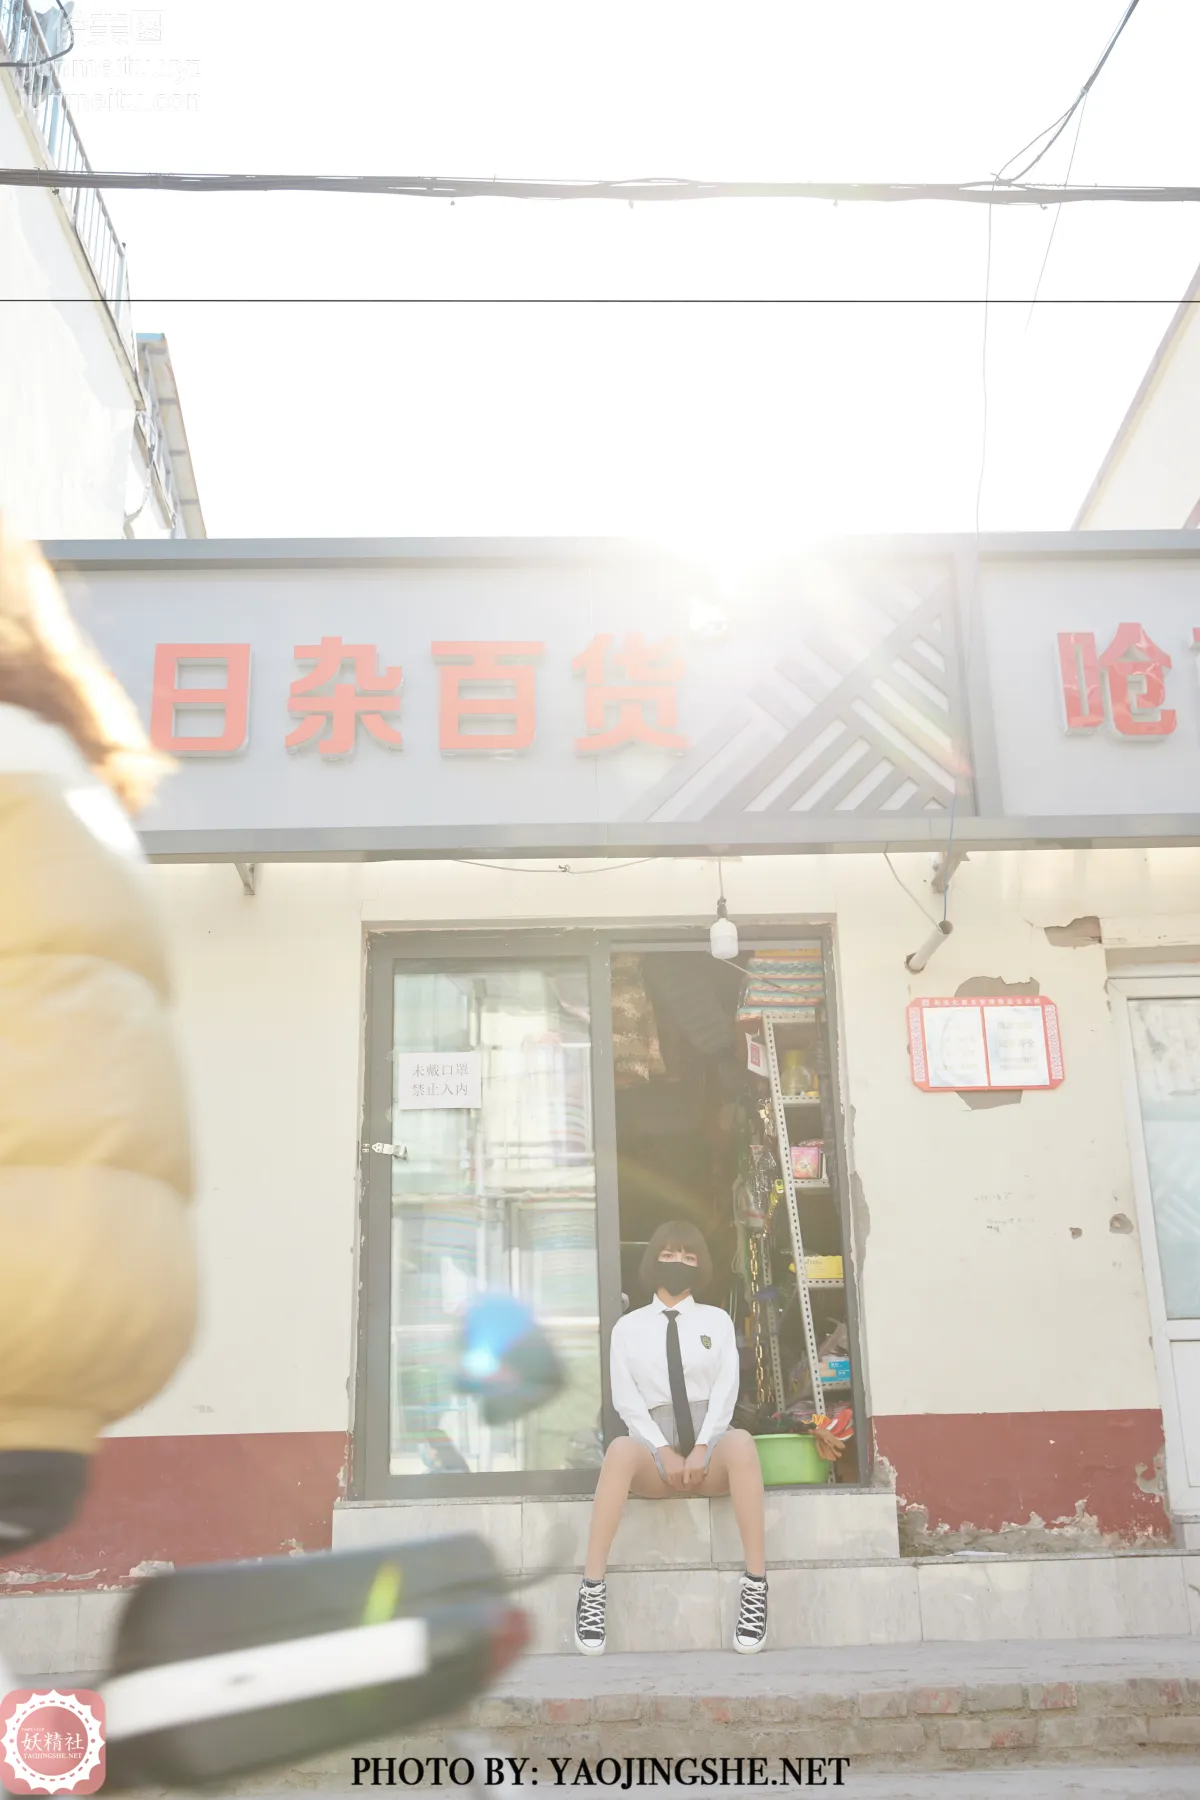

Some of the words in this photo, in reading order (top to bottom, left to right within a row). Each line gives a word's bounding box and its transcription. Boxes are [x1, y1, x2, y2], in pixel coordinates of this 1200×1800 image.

[150, 632, 690, 757] 日杂百货
[1057, 622, 1200, 737] 呛
[412, 1063, 469, 1078] 未戴口罩
[412, 1083, 469, 1097] 禁止入内
